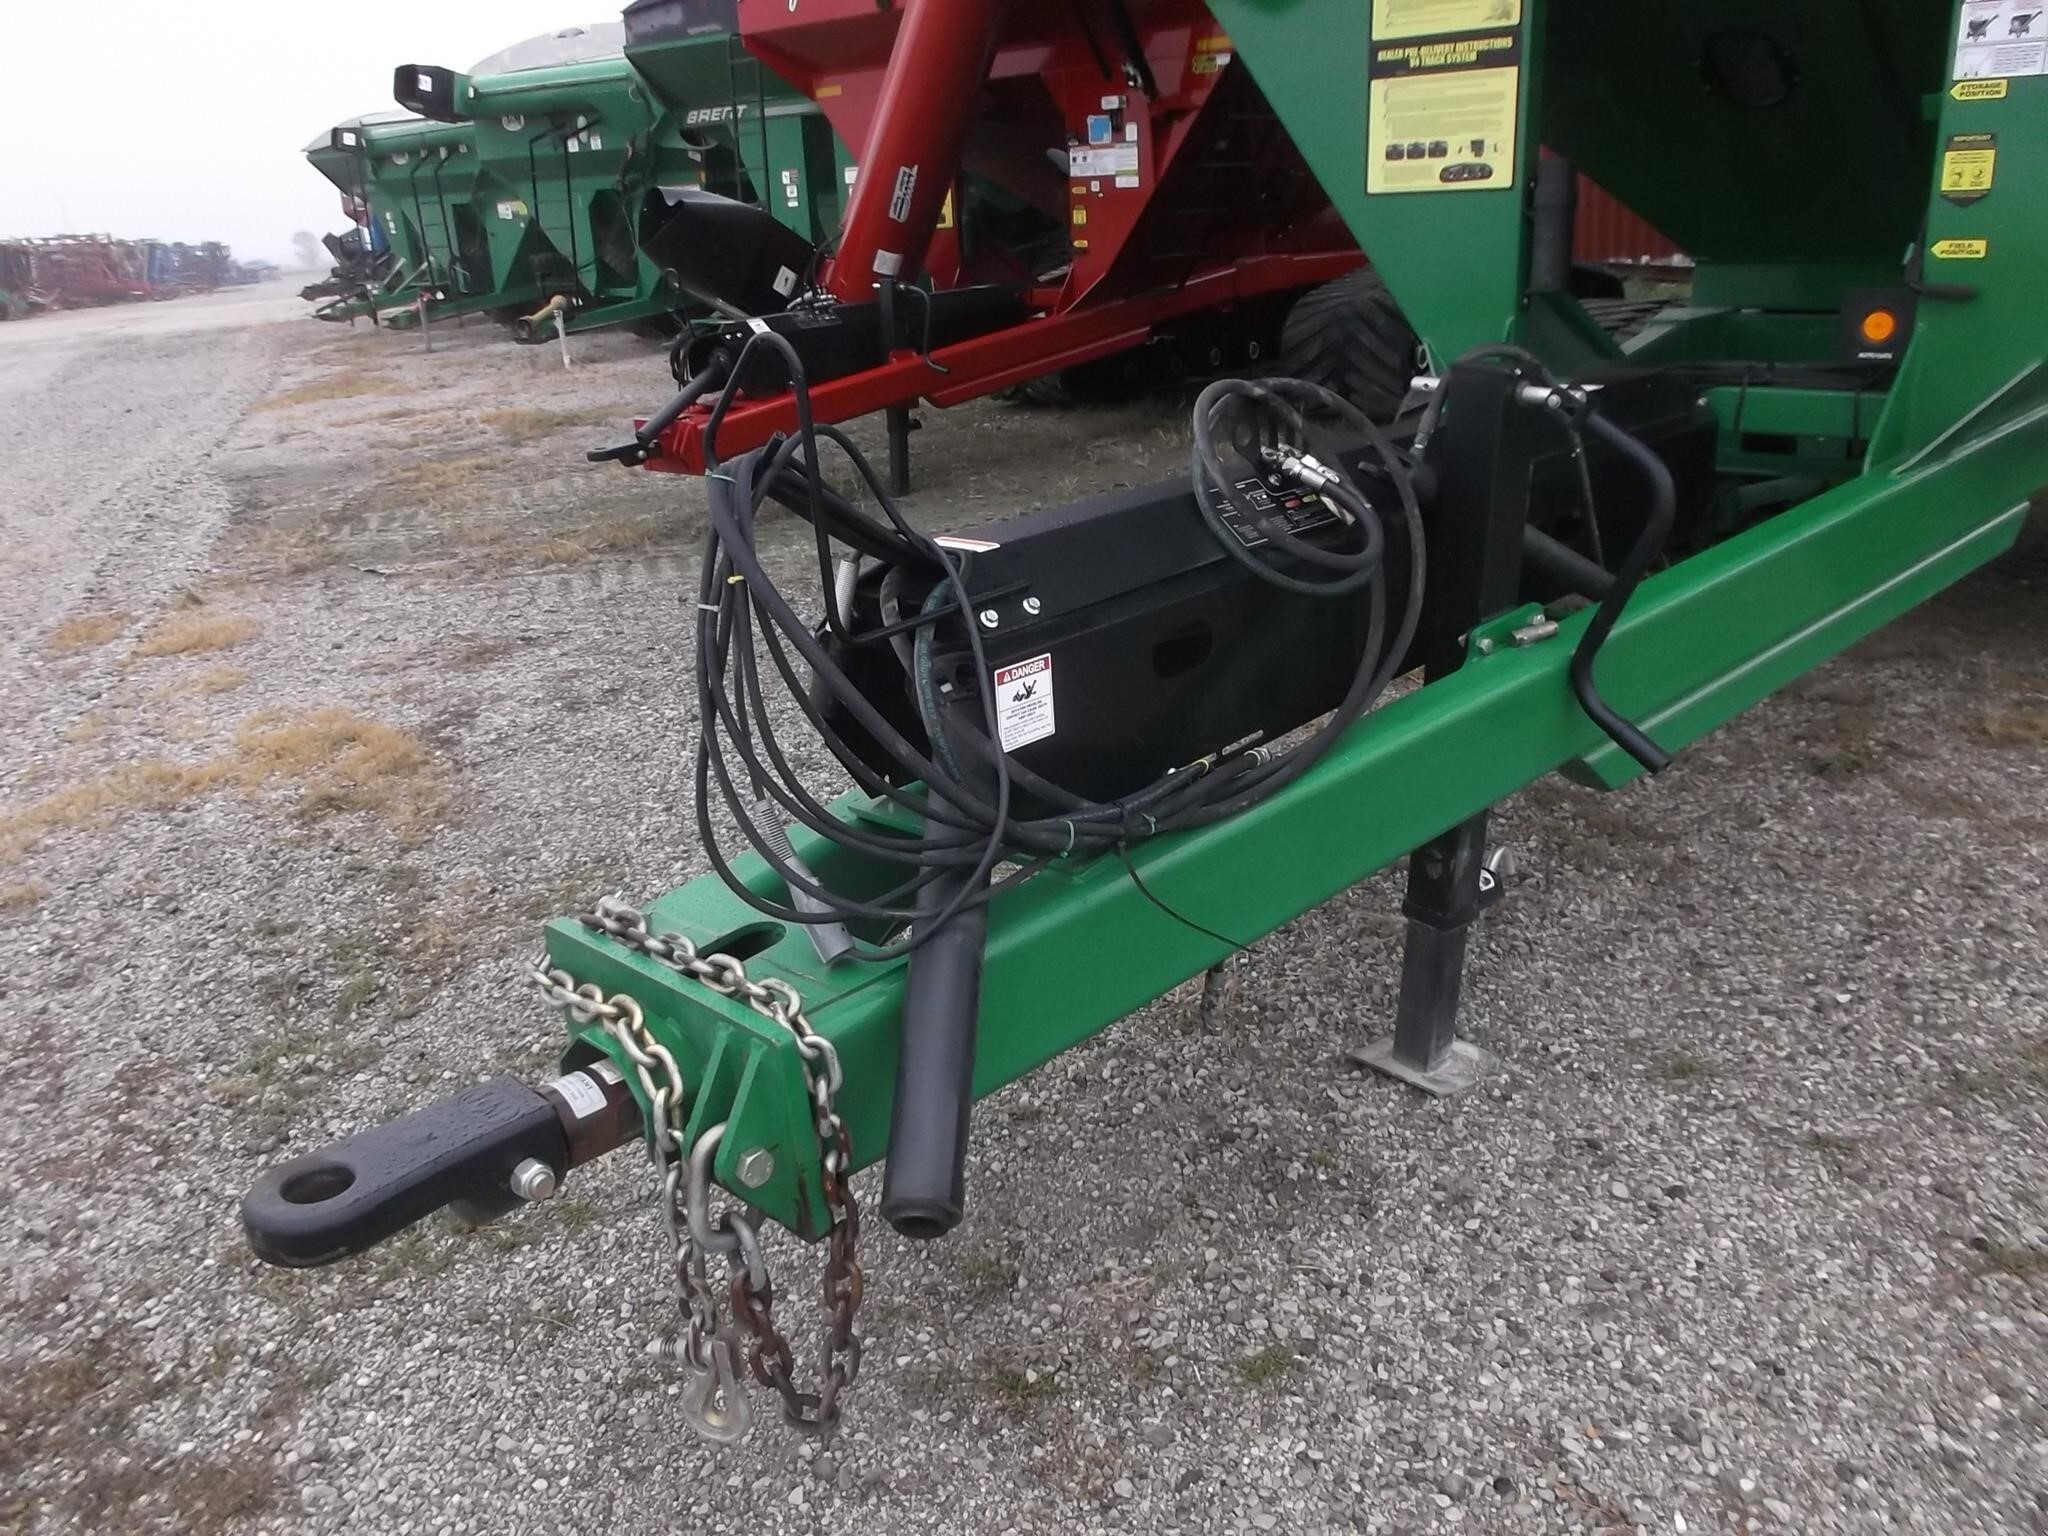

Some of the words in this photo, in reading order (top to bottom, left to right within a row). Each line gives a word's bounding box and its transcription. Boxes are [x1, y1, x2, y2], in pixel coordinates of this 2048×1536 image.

[1446, 51, 1478, 63] SYSTEM
[1960, 82, 2003, 91] STORAGE
[1959, 89, 2002, 97] POSITION
[686, 104, 747, 124] BRENT
[1011, 660, 1046, 680] DANGER
